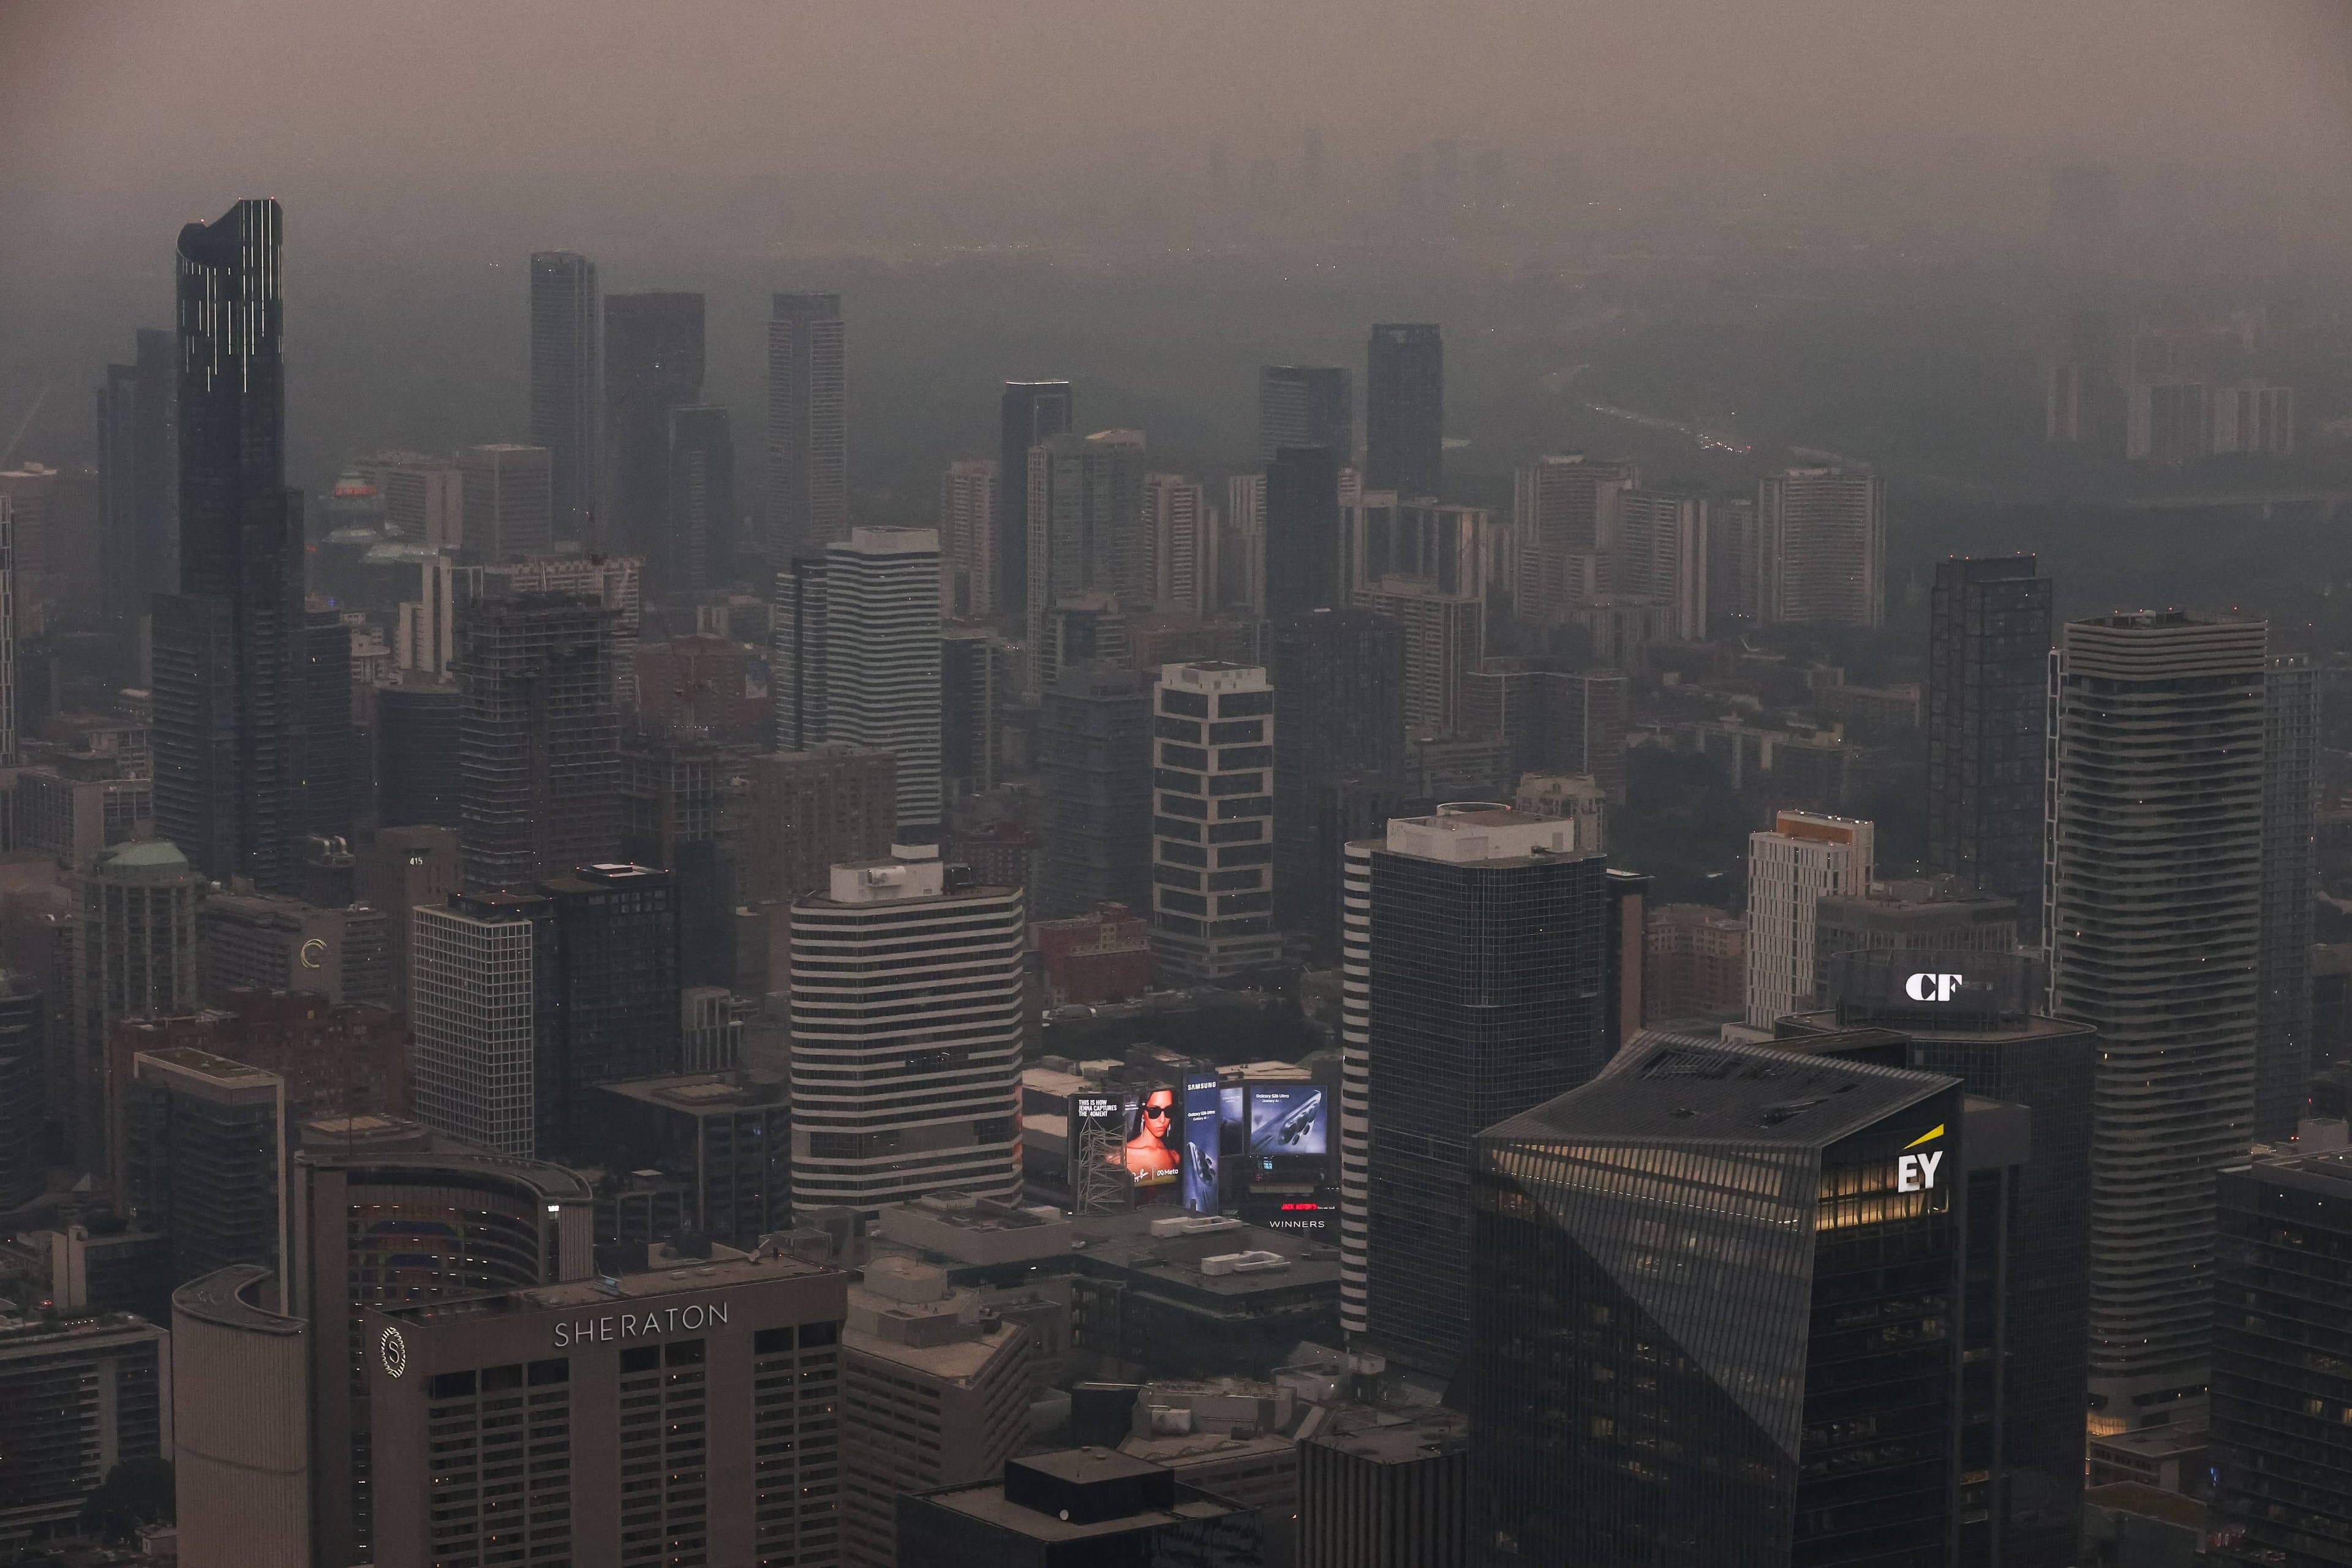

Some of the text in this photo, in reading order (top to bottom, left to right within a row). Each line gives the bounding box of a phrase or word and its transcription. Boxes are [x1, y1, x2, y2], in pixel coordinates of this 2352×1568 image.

[1905, 973, 1962, 1001] CF
[1188, 1082, 1216, 1090] SAMSUNG
[1898, 1151, 1943, 1193] EY
[555, 1302, 728, 1348] SHERATON
[389, 1341, 399, 1363] S
